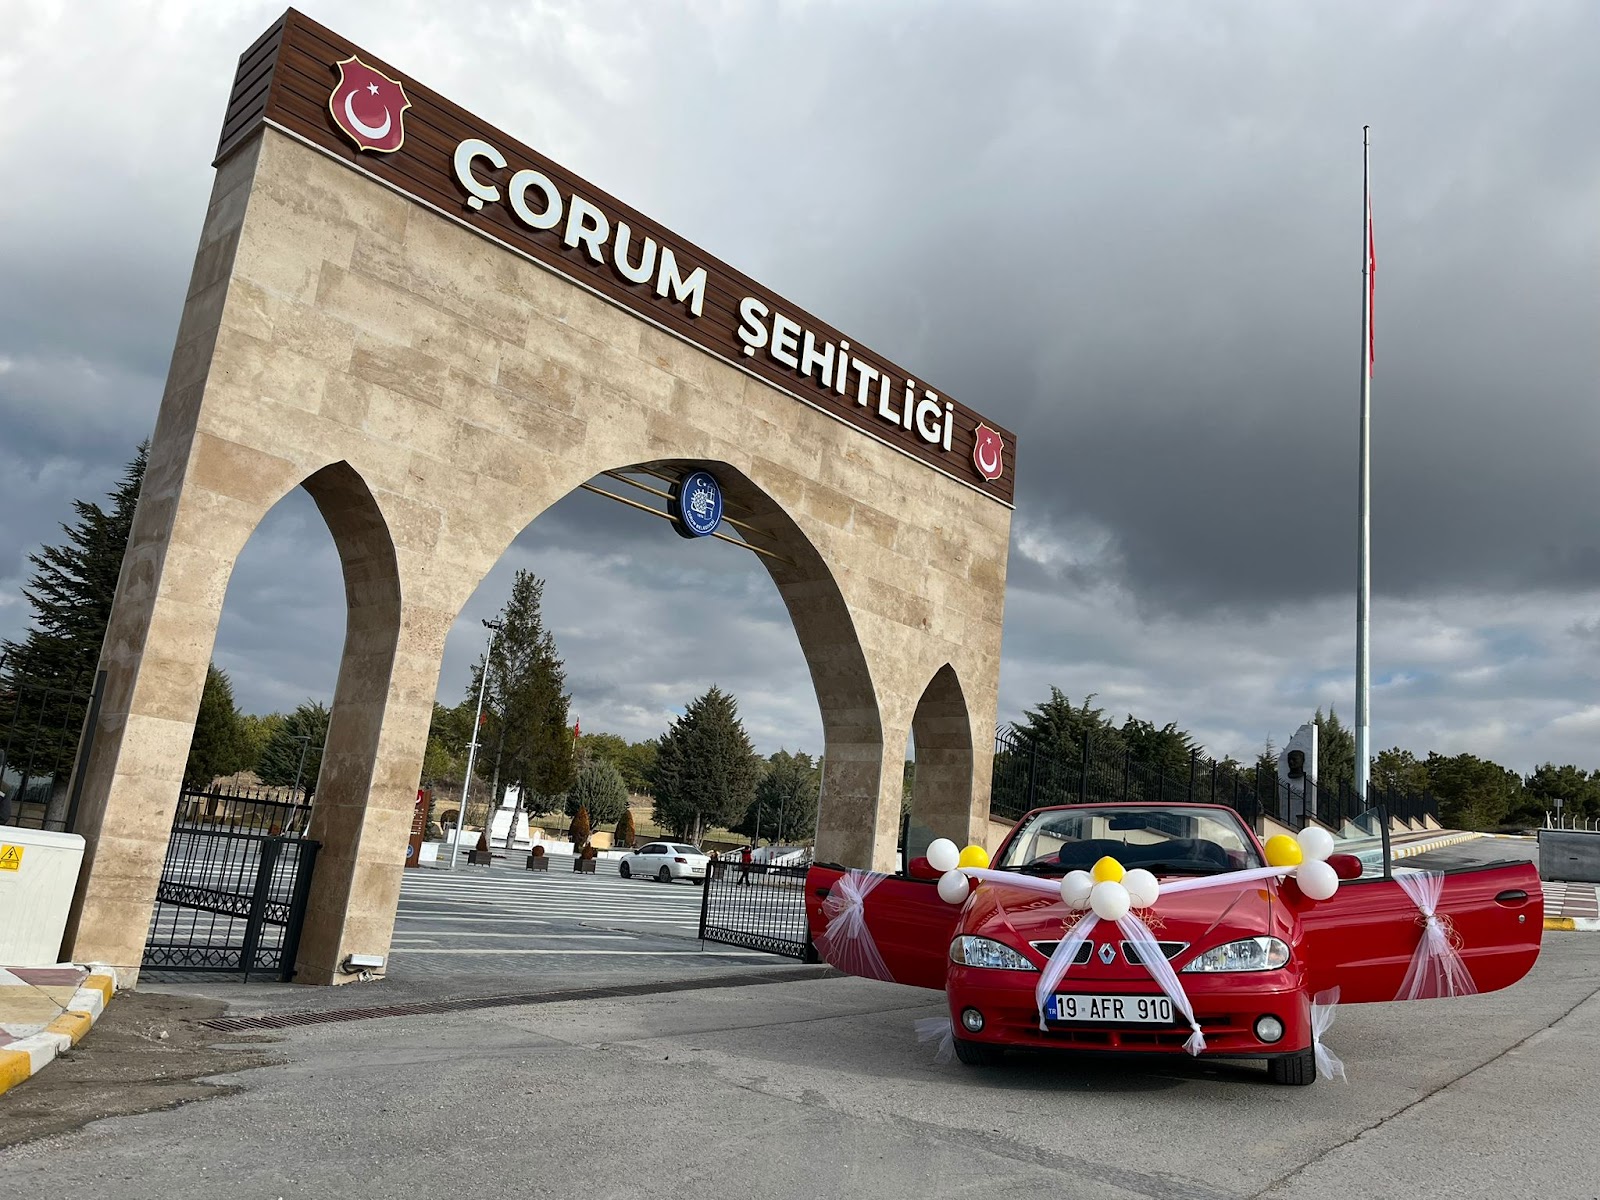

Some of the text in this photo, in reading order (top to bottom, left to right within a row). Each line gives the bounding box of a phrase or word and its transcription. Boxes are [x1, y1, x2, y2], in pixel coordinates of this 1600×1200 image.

[453, 138, 956, 452] ÇORUM ŞEHİTLİĞİ
[1057, 997, 1077, 1018] 19
[1090, 998, 1125, 1019] AFR
[1137, 999, 1170, 1020] 910
